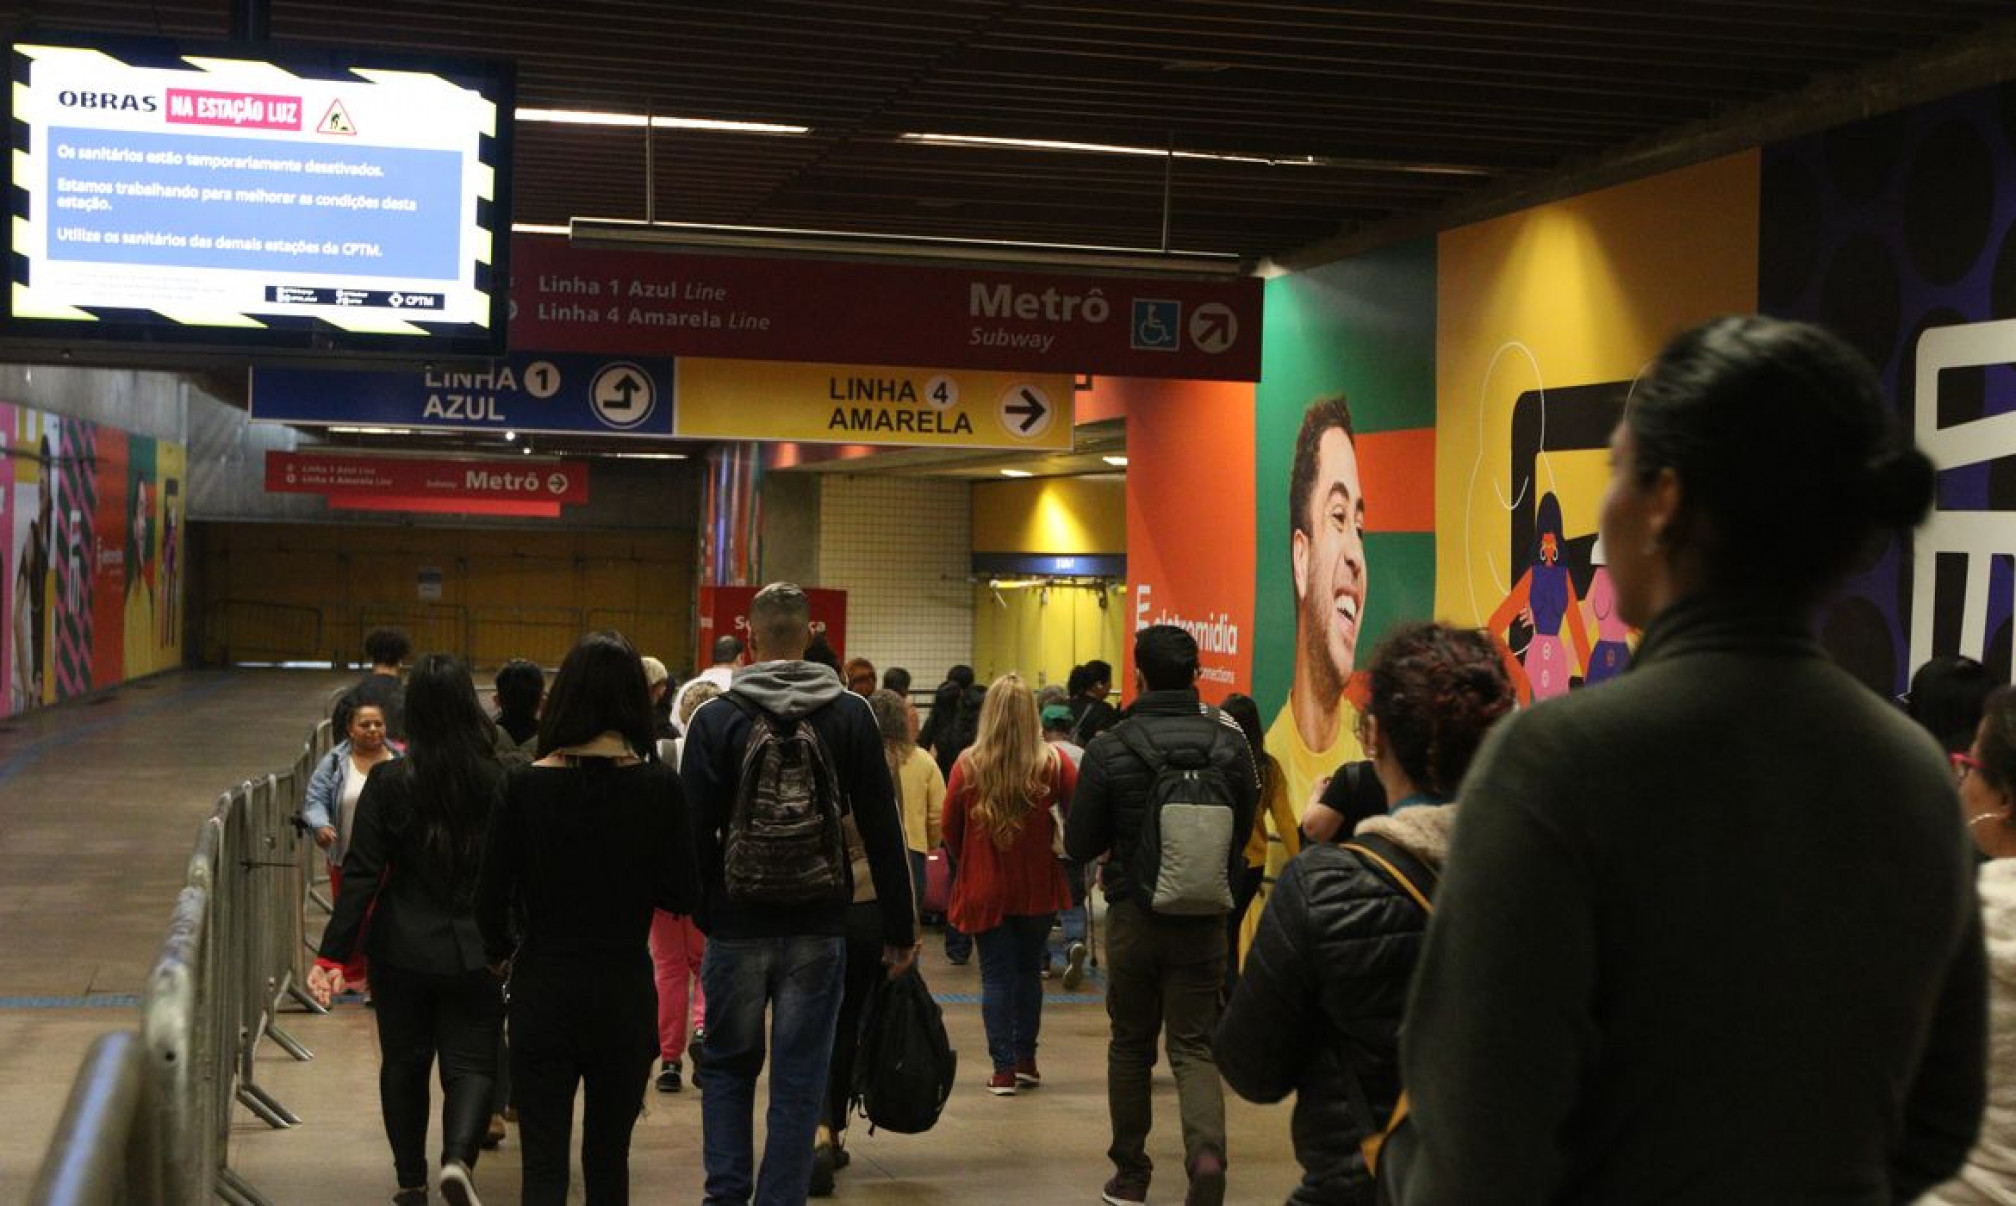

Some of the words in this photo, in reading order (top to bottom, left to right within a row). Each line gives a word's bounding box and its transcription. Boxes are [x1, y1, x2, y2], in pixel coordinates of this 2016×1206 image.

[58, 90, 158, 112] OBRAS
[170, 95, 193, 118] NA
[197, 95, 263, 125] ESTAÇÃO
[267, 101, 297, 123] LUZ
[57, 144, 75, 159] Os
[78, 146, 144, 163] sanitários
[146, 150, 182, 165] estão
[186, 153, 302, 172] temporariamente
[305, 159, 384, 177] desativados.
[57, 177, 113, 194] Estamos
[115, 180, 199, 199] trabalhando
[202, 187, 232, 202] para
[236, 188, 296, 204] melhorar
[299, 193, 313, 206] as
[316, 194, 379, 211] condições
[382, 195, 417, 212] desta
[57, 196, 113, 212] estação.
[57, 227, 101, 243] Utilize
[104, 232, 119, 244] os
[122, 230, 187, 247] sanitários
[189, 234, 213, 249] das
[215, 235, 262, 251] demais
[264, 240, 320, 256] estações
[322, 241, 339, 256] da
[342, 242, 384, 257] CPTM.
[406, 295, 434, 307] CPTM
[539, 275, 600, 295] Linha
[609, 279, 619, 295] 1
[628, 280, 677, 299] Azul
[685, 282, 727, 301] Line
[969, 281, 1110, 323] Metrô
[538, 302, 599, 323] Linha
[606, 307, 620, 323] 4
[627, 307, 722, 329] Amarela
[729, 312, 771, 331] Line
[969, 327, 1054, 354] Subway
[425, 367, 518, 391] LINHA
[535, 369, 548, 391] 1
[829, 377, 917, 403] LINHA
[933, 381, 949, 404] 4
[423, 394, 506, 421] AZUL
[828, 407, 973, 434] AMARELA
[466, 470, 540, 491] Metrô
[1153, 608, 1238, 656] omidia
